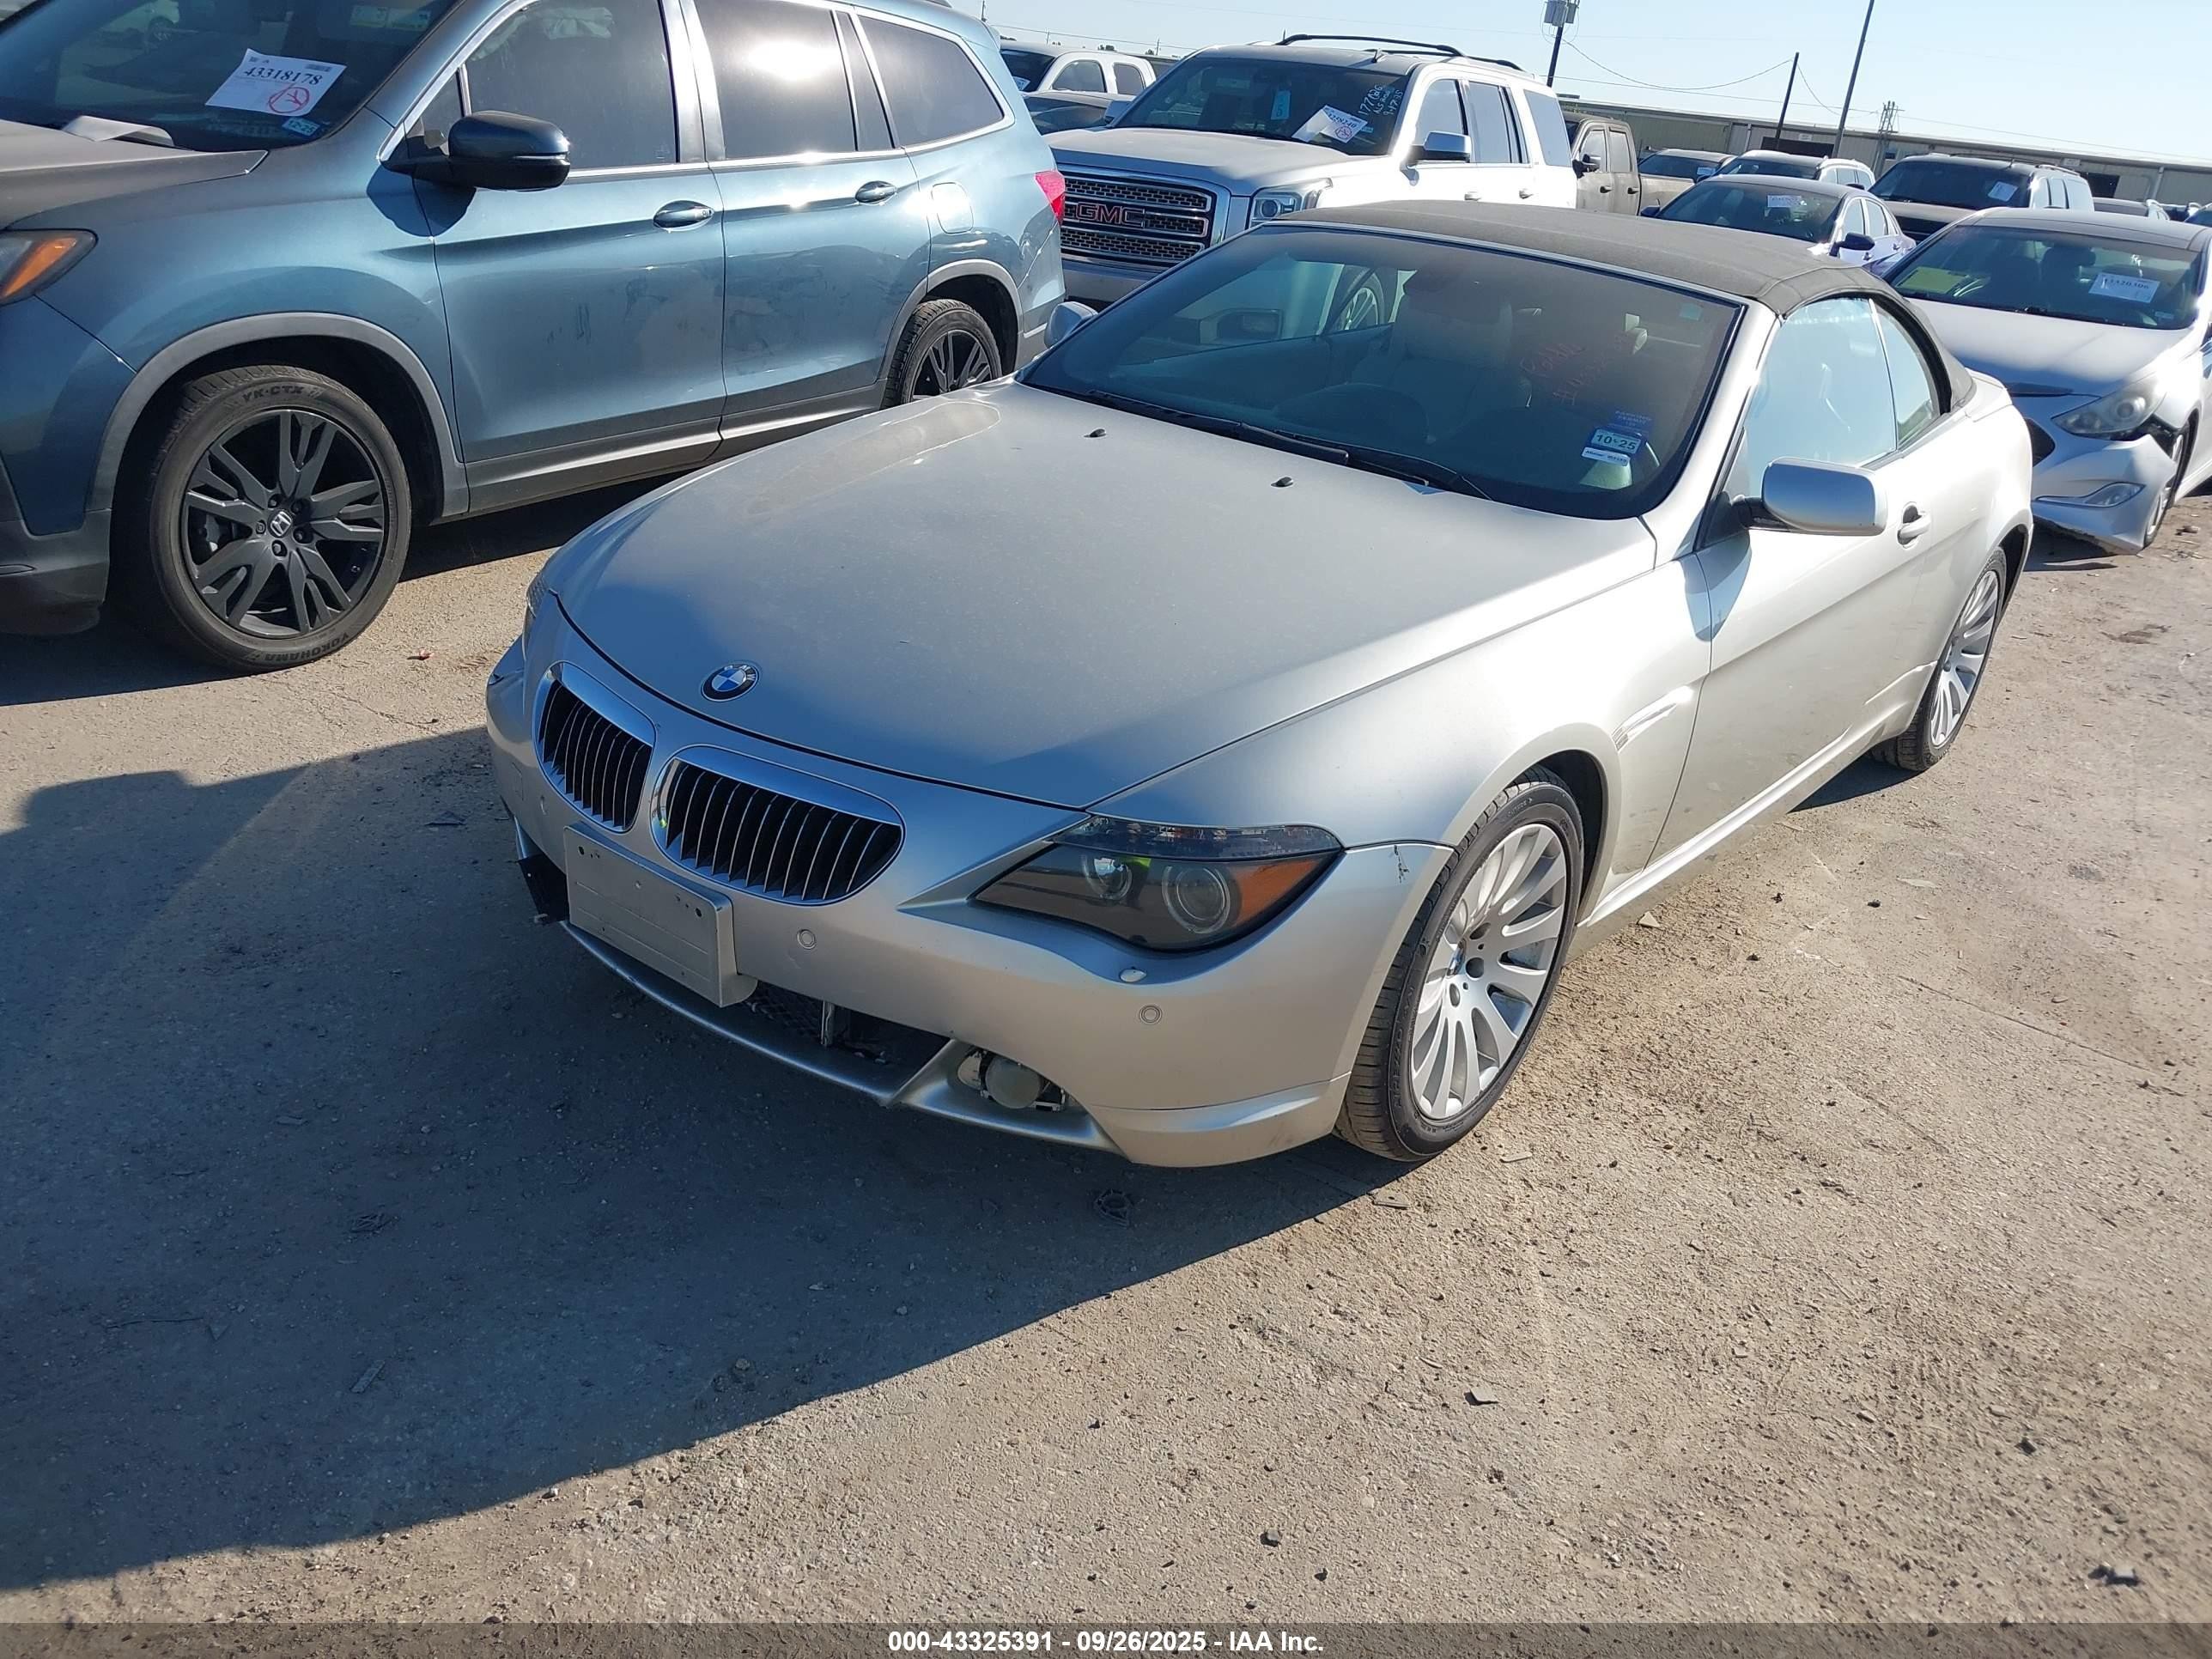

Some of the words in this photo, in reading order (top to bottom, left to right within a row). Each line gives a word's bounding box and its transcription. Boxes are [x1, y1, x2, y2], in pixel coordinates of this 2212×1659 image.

[245, 66, 324, 86] 43318178
[1076, 201, 1146, 229] GMC
[264, 632, 349, 661] YOKOHAMA
